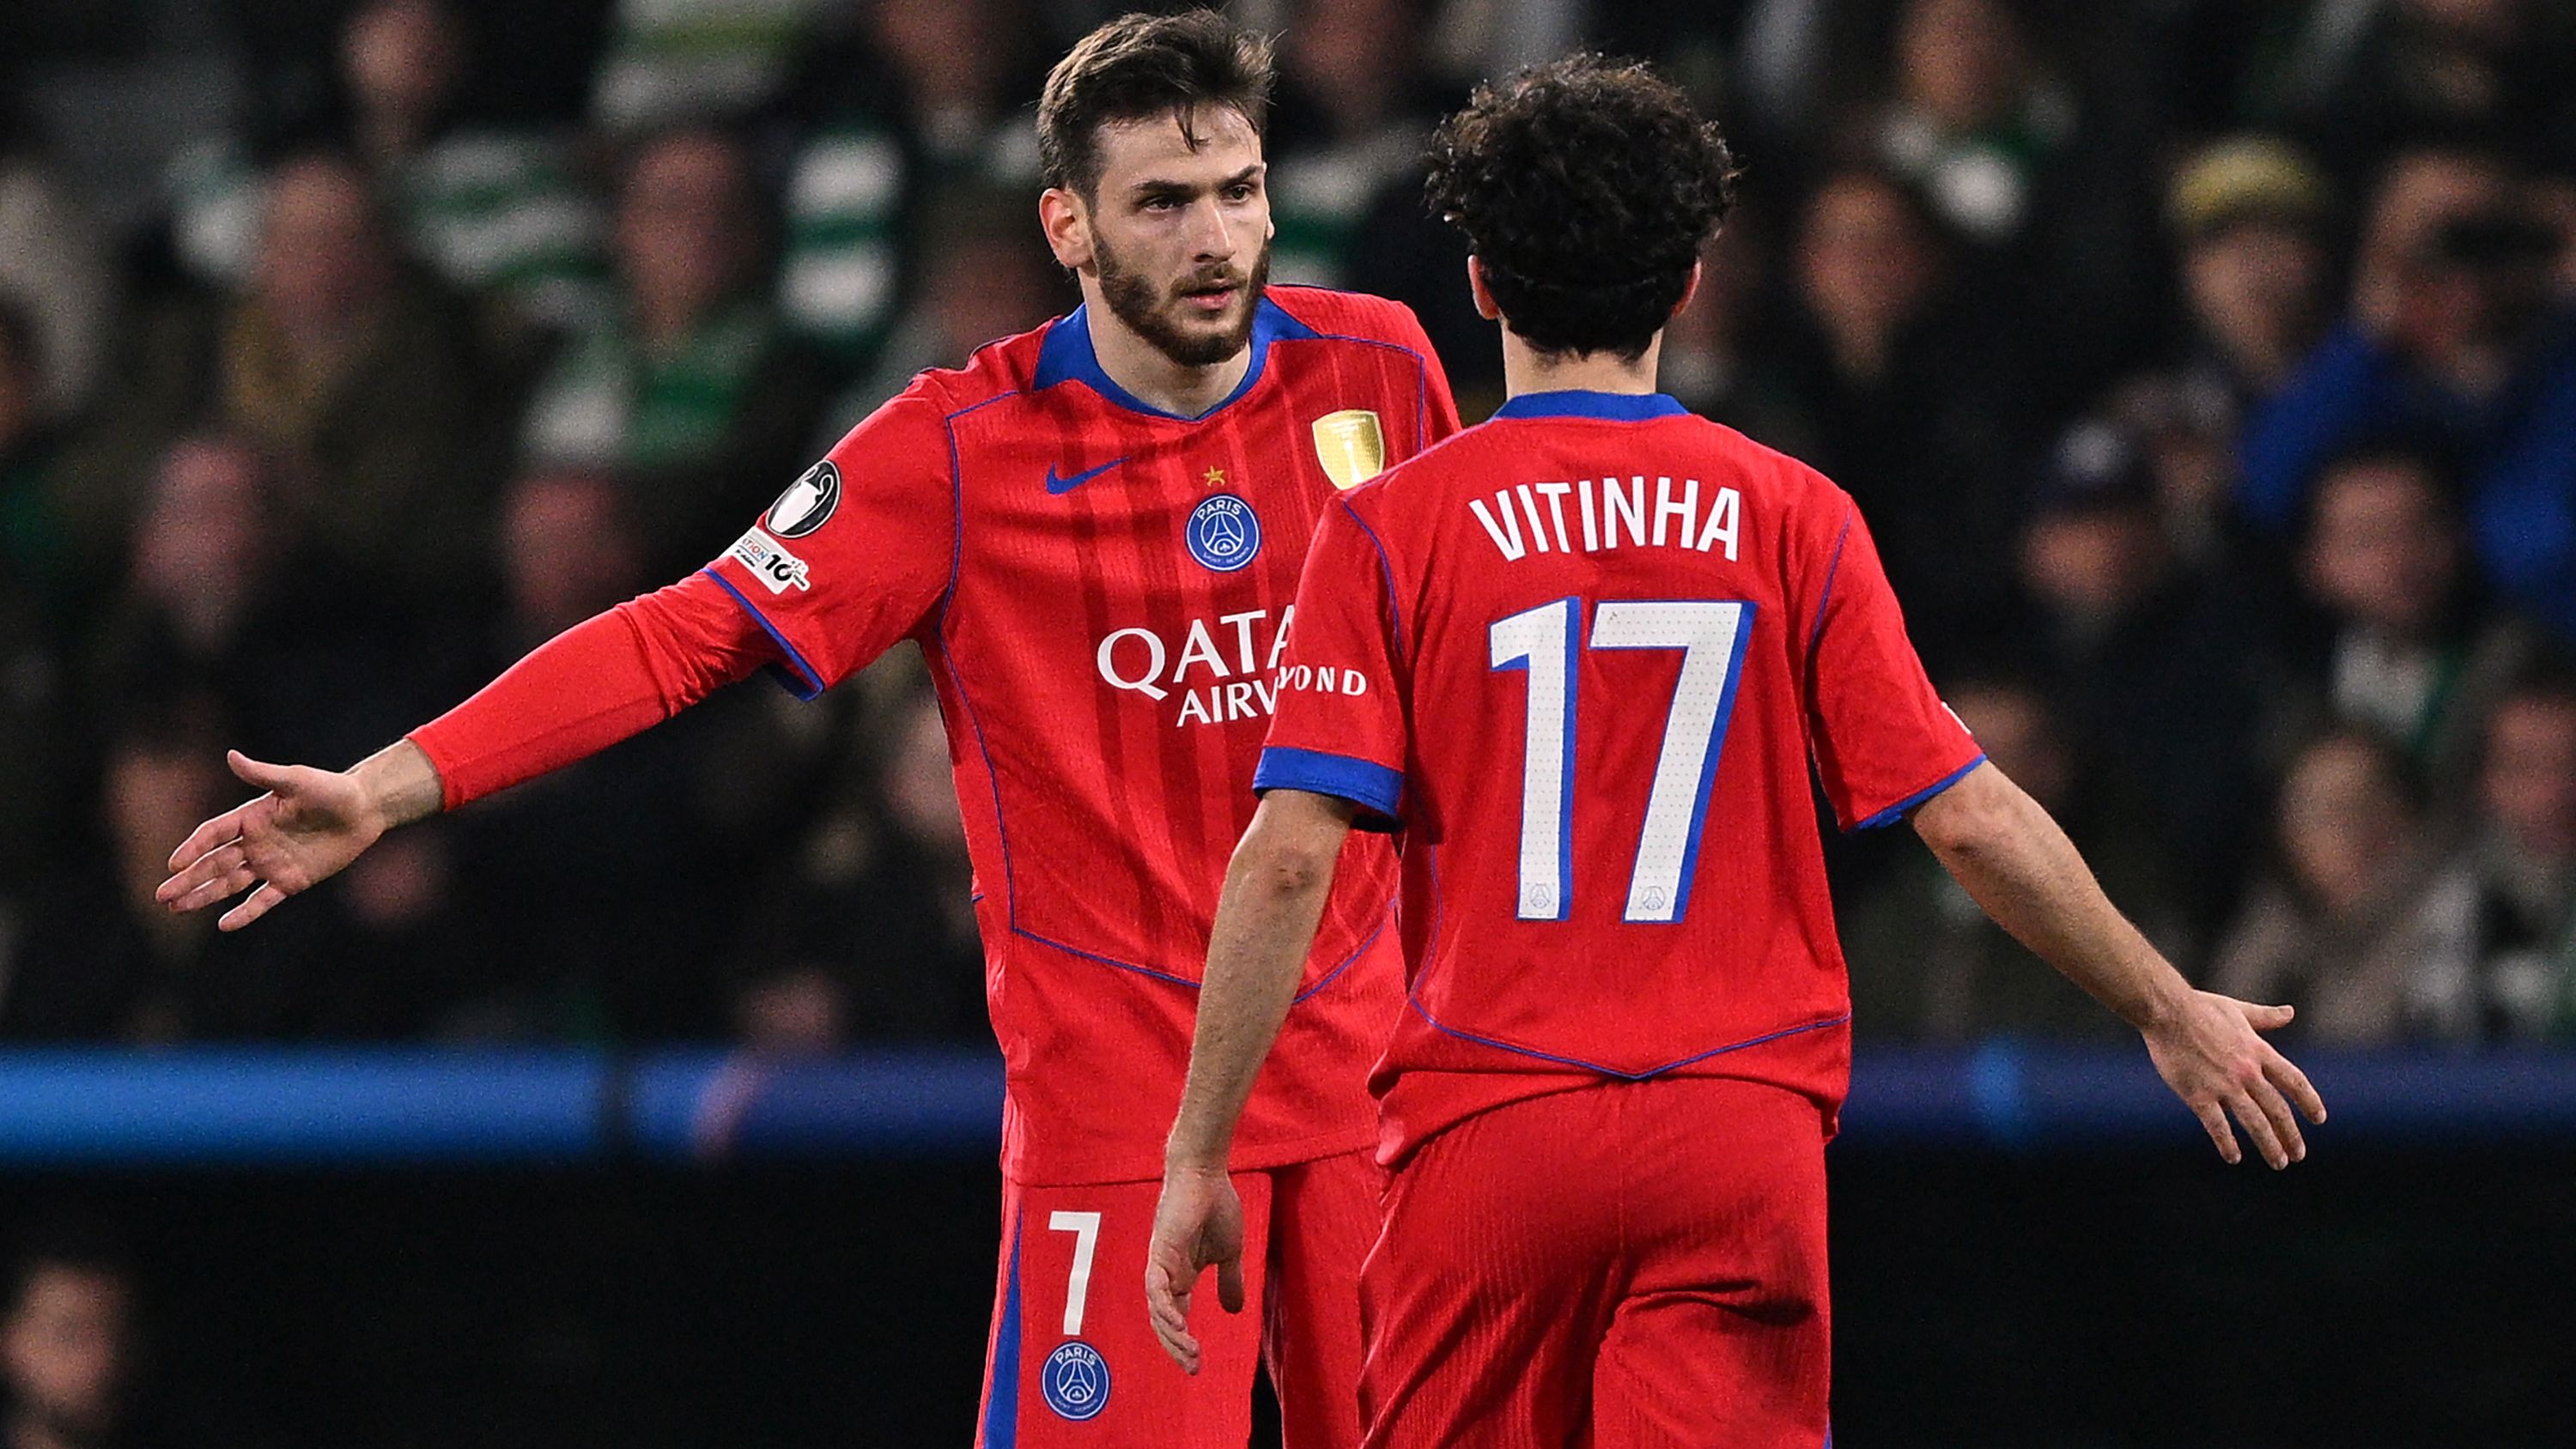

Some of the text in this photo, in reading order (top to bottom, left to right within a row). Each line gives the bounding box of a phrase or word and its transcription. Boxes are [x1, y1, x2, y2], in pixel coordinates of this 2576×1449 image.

[1196, 500, 1242, 520] PARIS
[1468, 476, 1741, 562] VITINHA
[1488, 596, 1759, 924] 17
[1048, 1210, 1102, 1336] 7
[1054, 1347, 1097, 1366] PARIS
